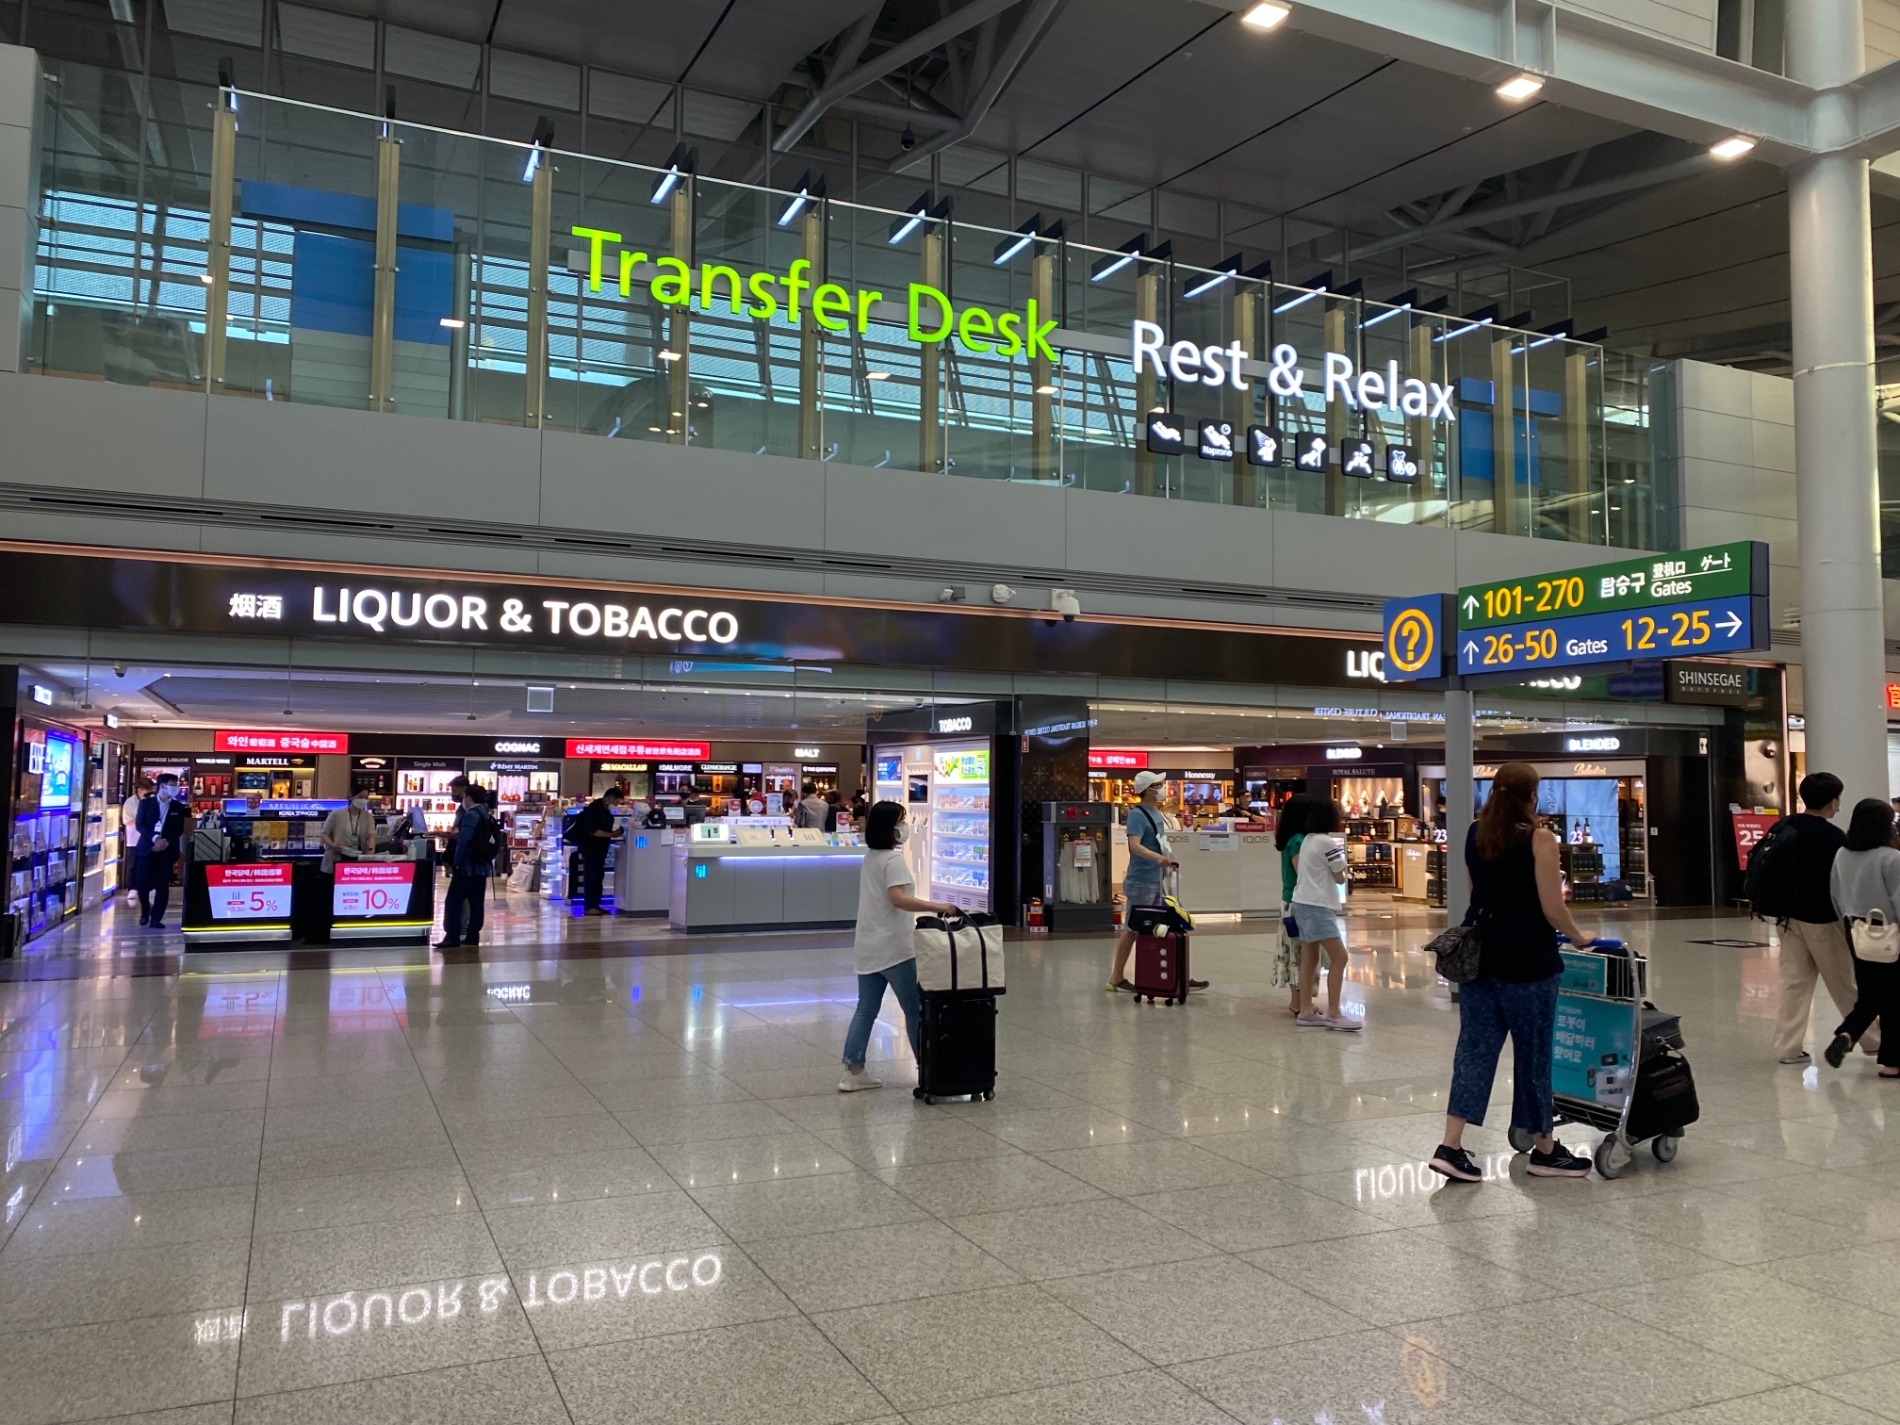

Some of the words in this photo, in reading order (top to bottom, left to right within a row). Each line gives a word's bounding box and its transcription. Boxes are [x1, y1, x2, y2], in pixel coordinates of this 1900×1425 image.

[571, 225, 883, 334] Transfer
[908, 282, 1060, 363] Desk
[1132, 319, 1249, 391] Rest
[1268, 343, 1305, 398] &
[1324, 352, 1457, 421] Relax
[1203, 445, 1233, 458] Napzone
[1701, 552, 1732, 571] ゲート
[1652, 561, 1686, 580] 登机口
[1600, 571, 1646, 599] 탑승구
[1650, 578, 1693, 598] Gates
[1483, 576, 1585, 618] 101-270
[229, 593, 283, 620] 烟酒
[311, 586, 488, 633] LIQUOR
[500, 598, 533, 633] &
[543, 600, 740, 644] TOBACCO
[1483, 628, 1558, 666] 26-50
[1566, 638, 1609, 657] Gates
[1621, 610, 1711, 651] 12-25
[1678, 670, 1742, 688] SHINSEGAE
[939, 717, 972, 732] TOBACCO
[495, 742, 541, 754] COGNAC
[1568, 738, 1621, 751] BLENDED
[795, 748, 820, 758] MALT
[246, 757, 290, 766] MARTELL
[413, 760, 432, 769] Single
[514, 763, 538, 771] MARTIN
[662, 764, 694, 772] DALMORE
[701, 763, 738, 772] GLENMORANGIE
[1185, 771, 1216, 780] Hennessy
[1332, 768, 1350, 776] ROYAL
[1351, 768, 1376, 776] SALUTE
[1166, 835, 1189, 844] QOS
[1243, 835, 1270, 844] IQOS
[1570, 831, 1584, 845] 23
[362, 889, 400, 910] 10%
[1558, 1015, 1586, 1032] 로봇이
[1555, 1031, 1596, 1051] 배달하러
[1553, 1046, 1583, 1063] 왔어요
